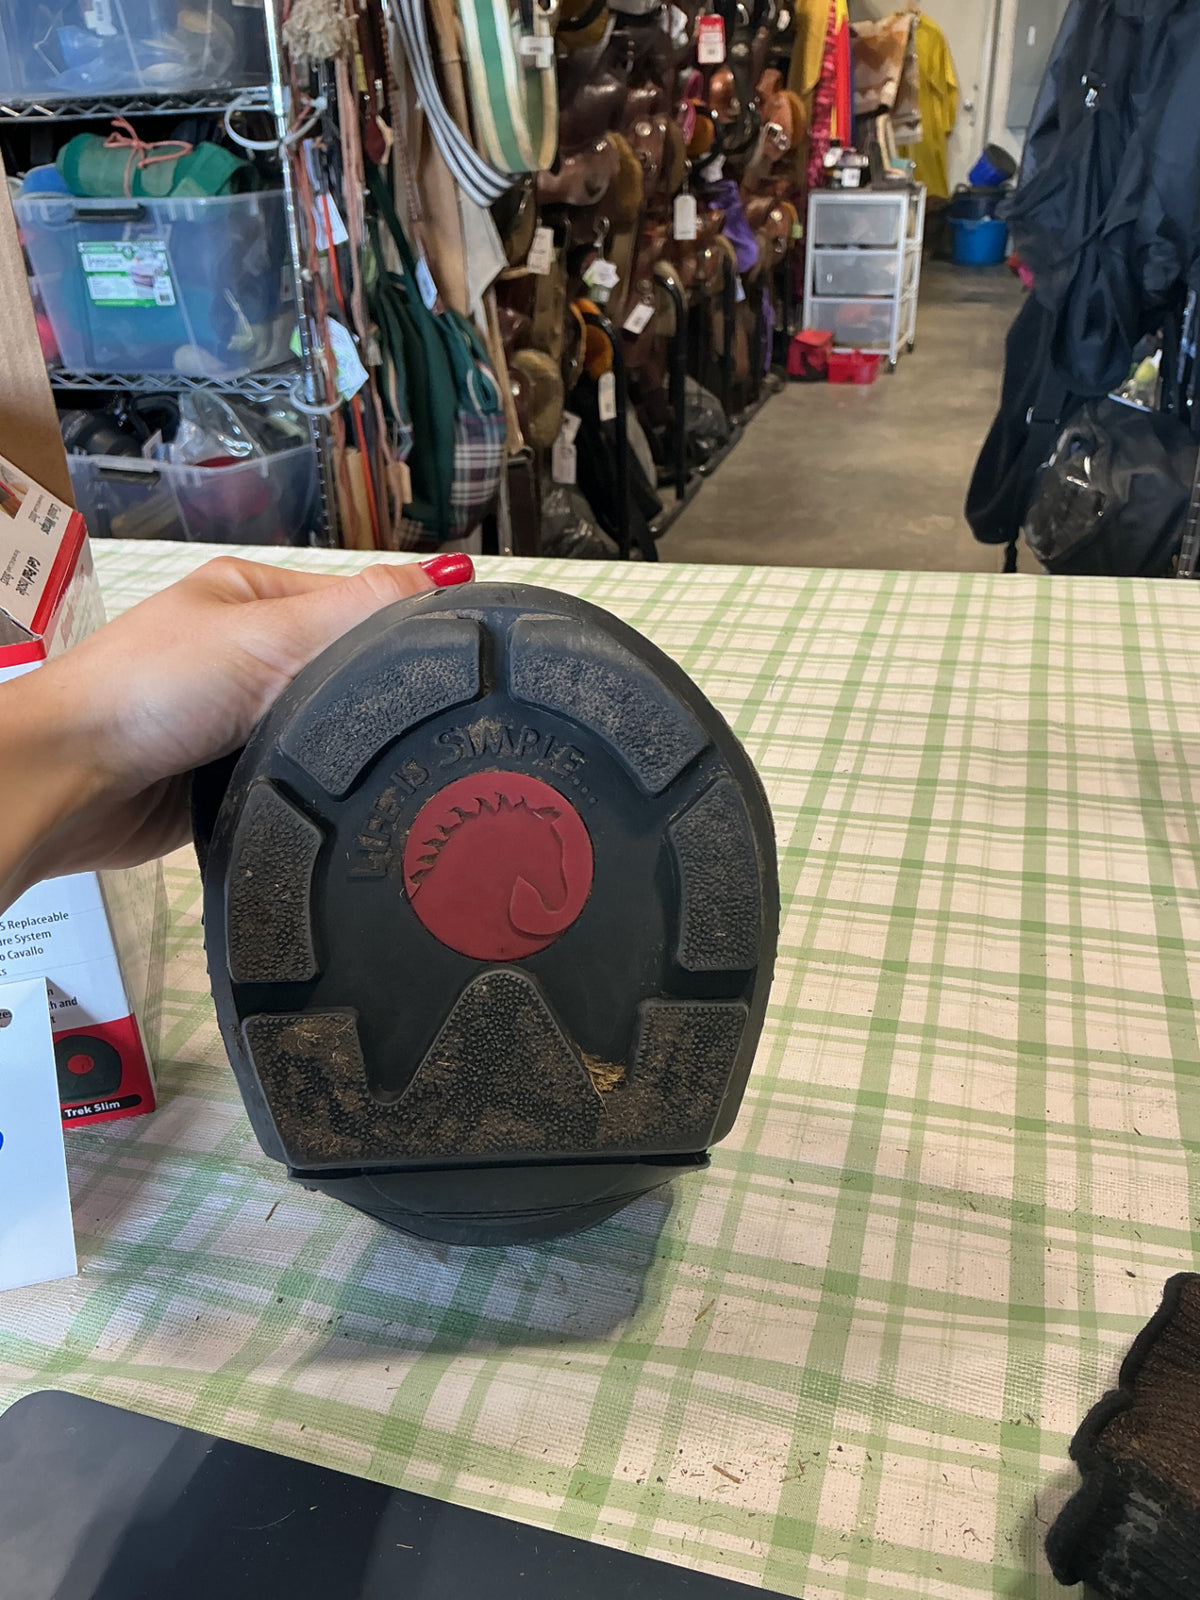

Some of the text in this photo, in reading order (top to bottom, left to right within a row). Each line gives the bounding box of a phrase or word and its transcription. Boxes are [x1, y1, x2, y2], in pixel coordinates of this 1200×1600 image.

[7, 911, 70, 930] Replaceable
[14, 931, 52, 945] System
[7, 946, 44, 960] Cavallo
[59, 996, 78, 1009] and
[64, 1101, 121, 1118] Trek Slim
